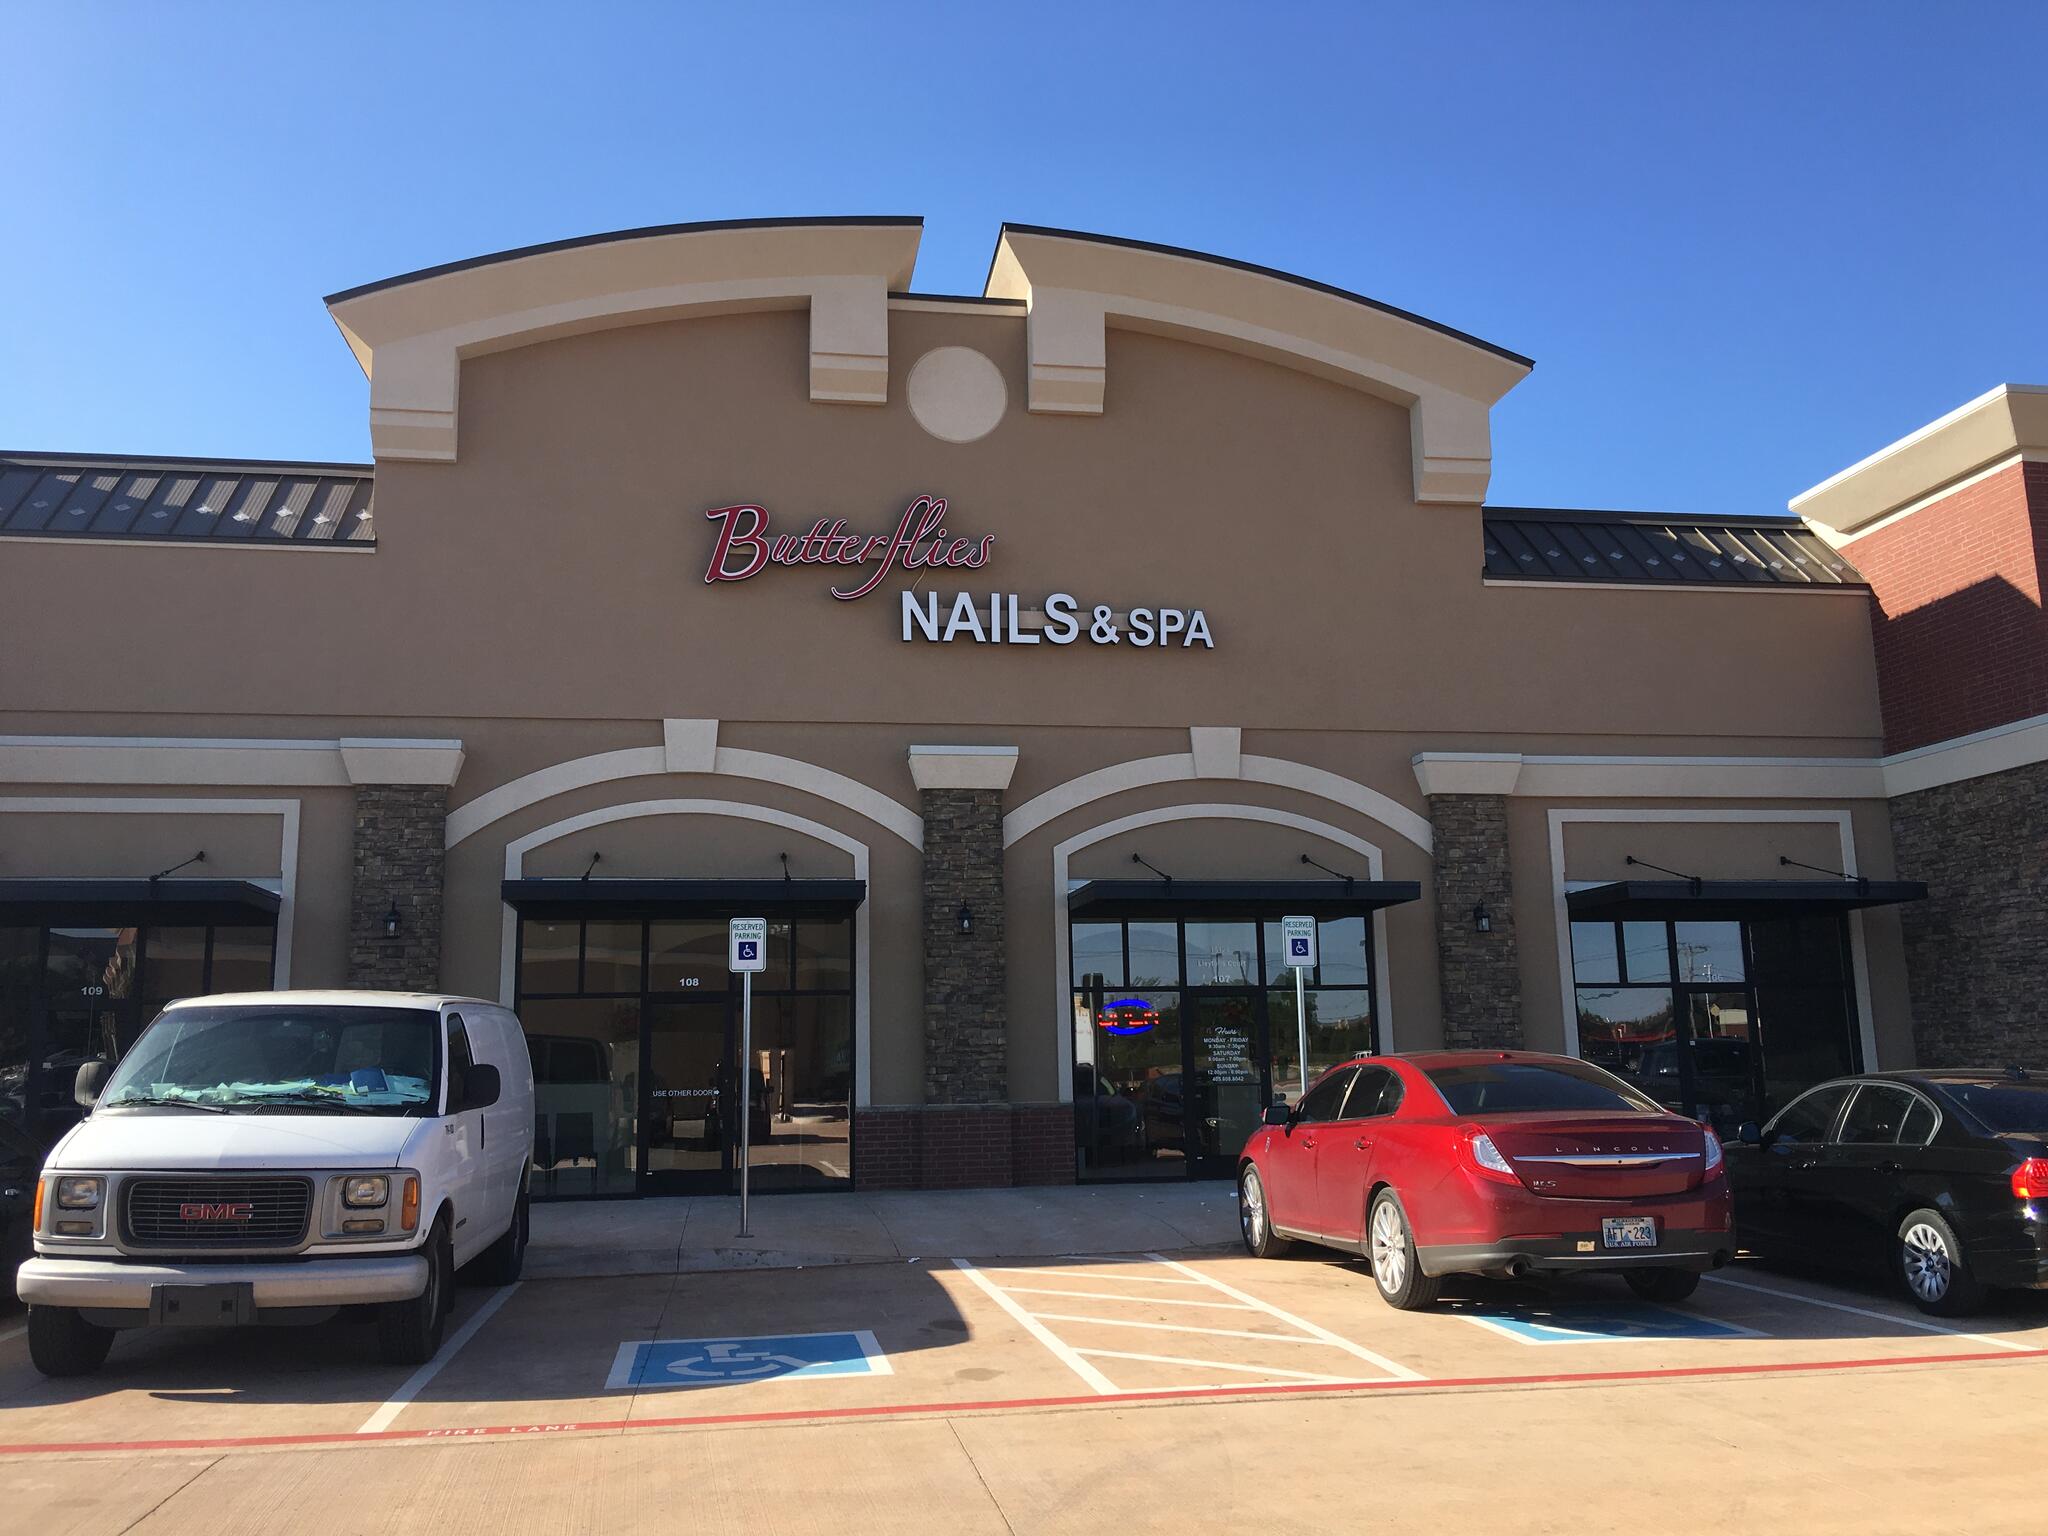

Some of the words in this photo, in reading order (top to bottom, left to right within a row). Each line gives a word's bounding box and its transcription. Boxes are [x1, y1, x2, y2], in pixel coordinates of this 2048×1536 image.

[704, 494, 995, 600] Butterflies
[901, 590, 1080, 645] NAILS
[1090, 605, 1120, 645] &
[1128, 607, 1214, 648] SPA
[732, 923, 764, 931] RESERVED
[734, 932, 762, 940] PARKING
[679, 977, 699, 987] 108
[81, 986, 103, 996] 109
[668, 1089, 692, 1097] OTHER
[1555, 1145, 1670, 1153] LINCOLN
[180, 1203, 254, 1220] GMC
[427, 1428, 487, 1436] FIRE
[509, 1424, 577, 1433] LANE
